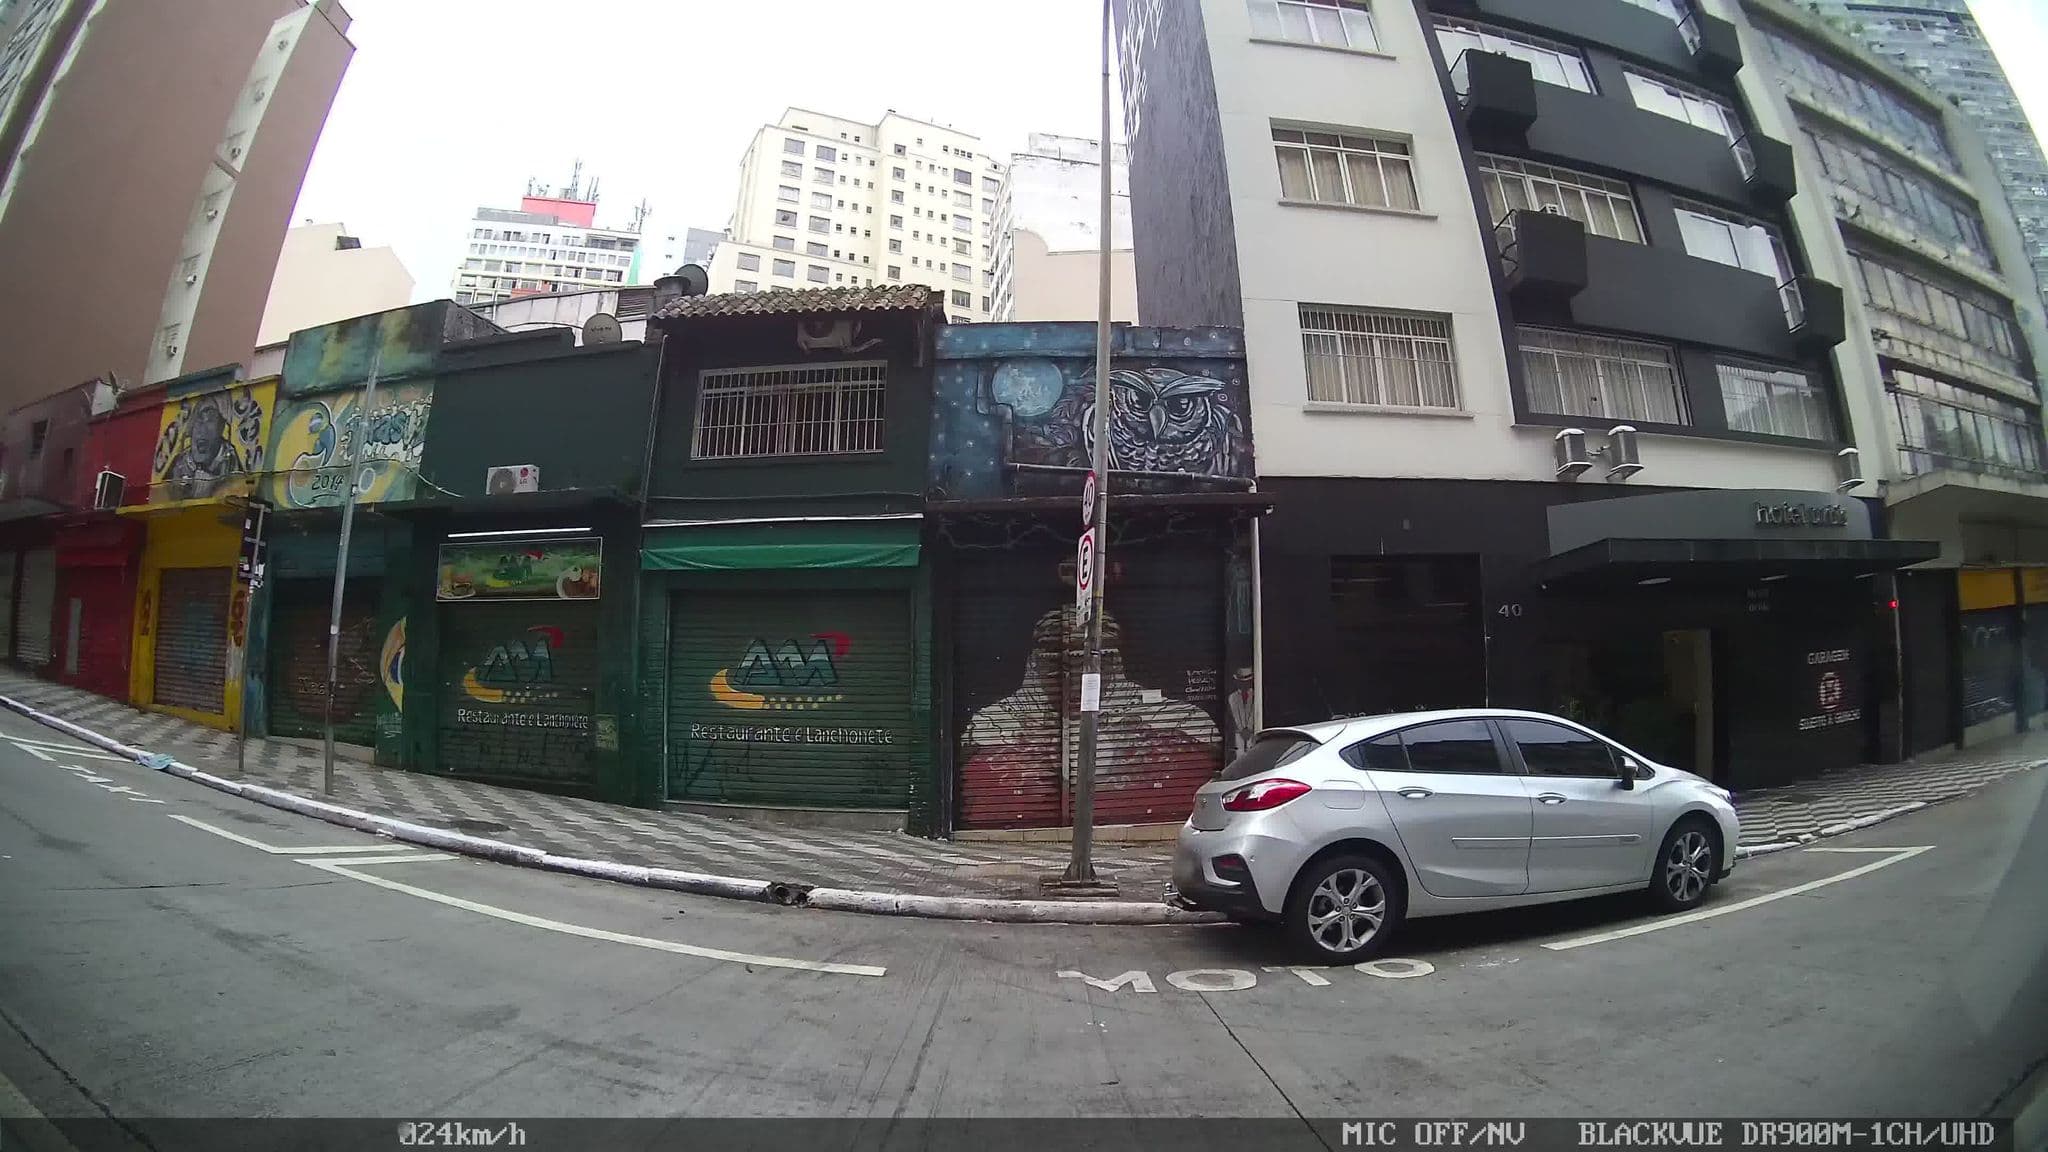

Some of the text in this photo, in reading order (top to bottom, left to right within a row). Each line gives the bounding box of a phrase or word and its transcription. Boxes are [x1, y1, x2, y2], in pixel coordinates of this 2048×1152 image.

[311, 475, 344, 491] 2014
[1498, 603, 1522, 617] 40
[457, 708, 589, 730] Restaurante e Lanchonete
[691, 722, 894, 745] Restaurante e Lanchonete
[1056, 958, 1435, 993] MOTO
